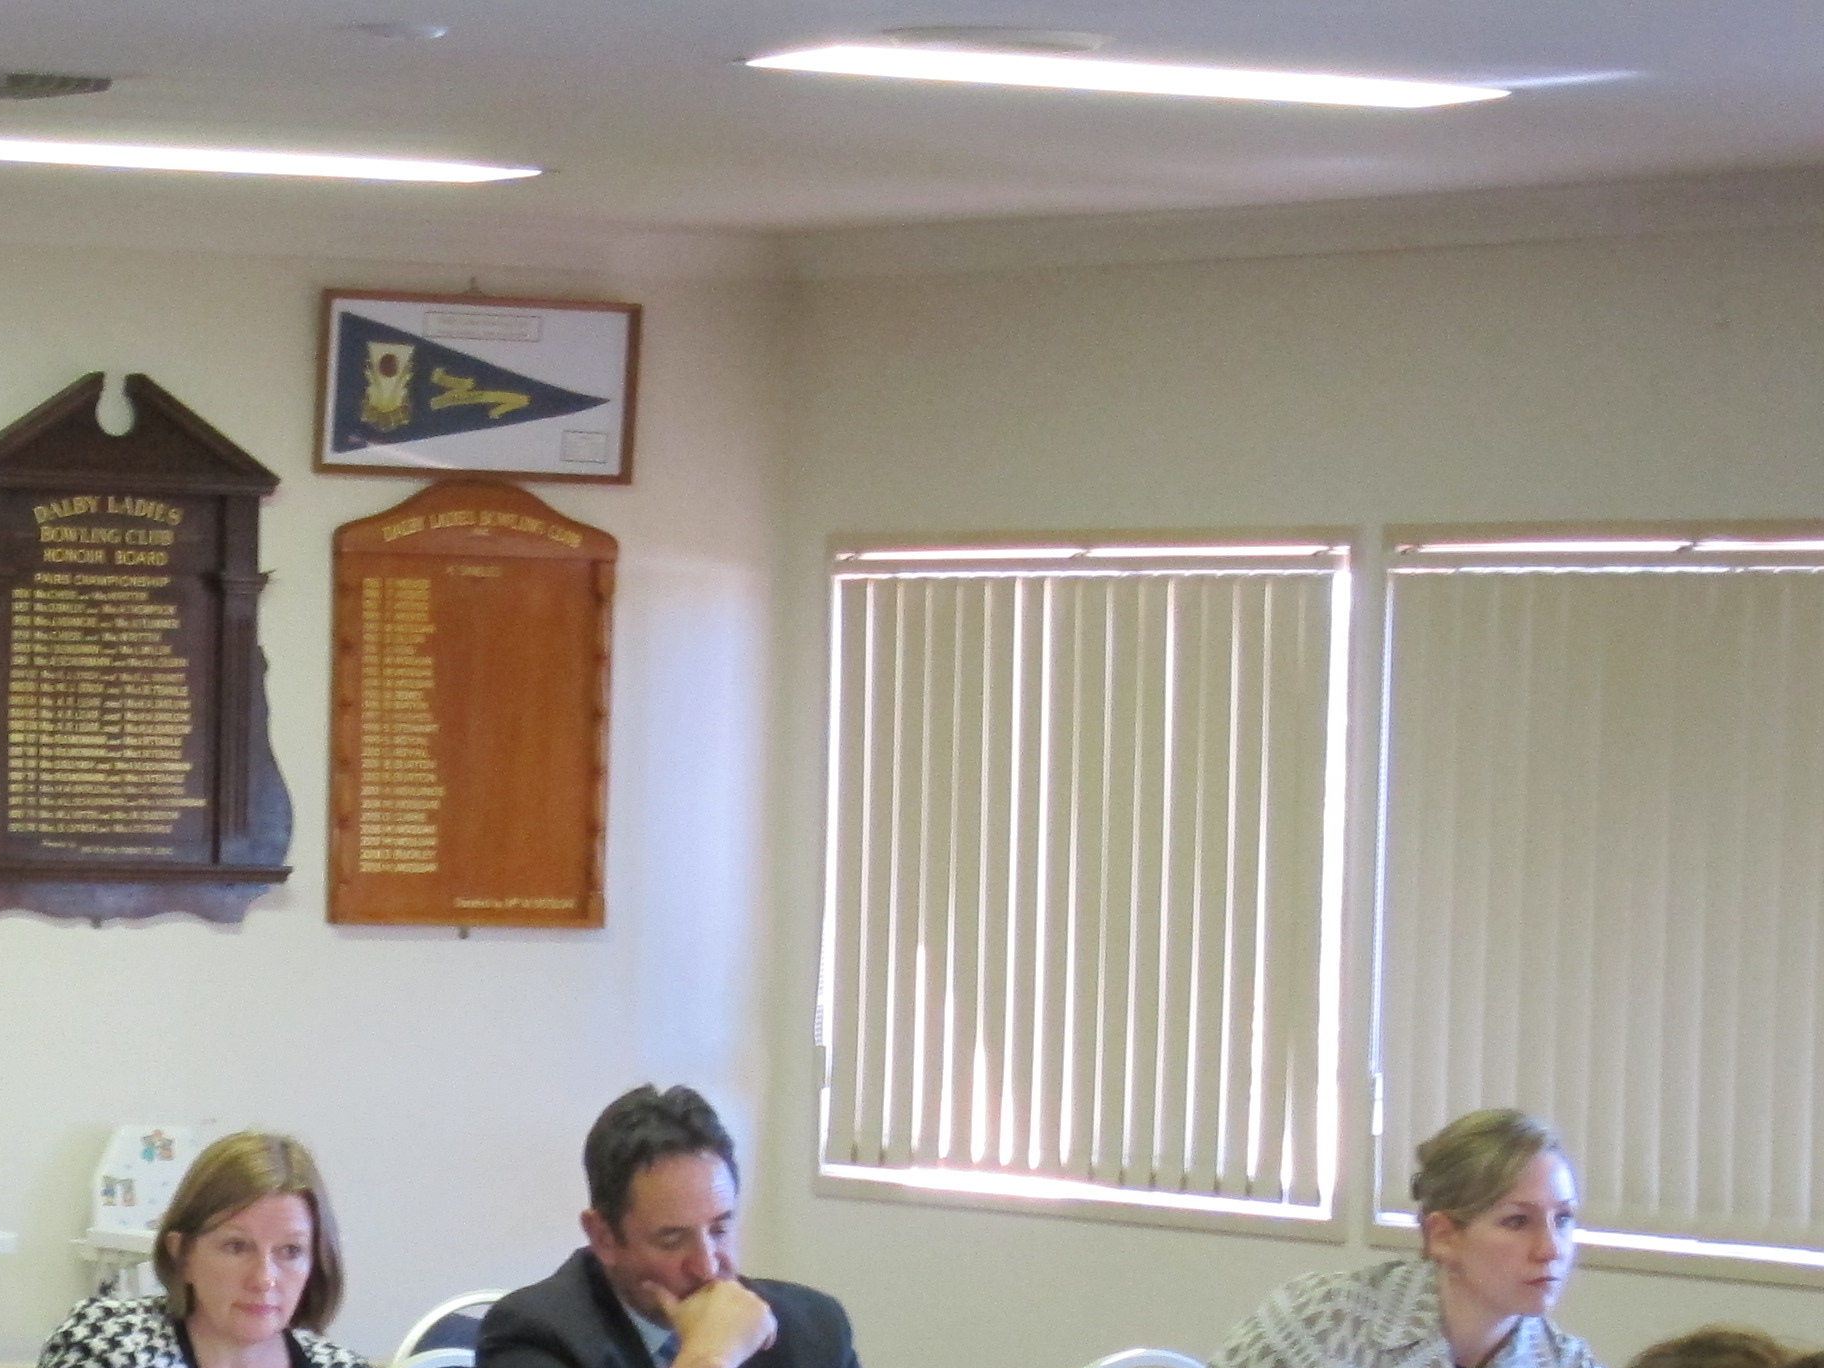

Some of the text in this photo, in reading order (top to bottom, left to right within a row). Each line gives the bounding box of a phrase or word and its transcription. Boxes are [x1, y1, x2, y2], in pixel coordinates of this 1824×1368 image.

[32, 495, 185, 526] DALBY LADIES
[39, 526, 175, 546] BOWLING CLUB
[42, 548, 169, 566] HONOUR BOARD
